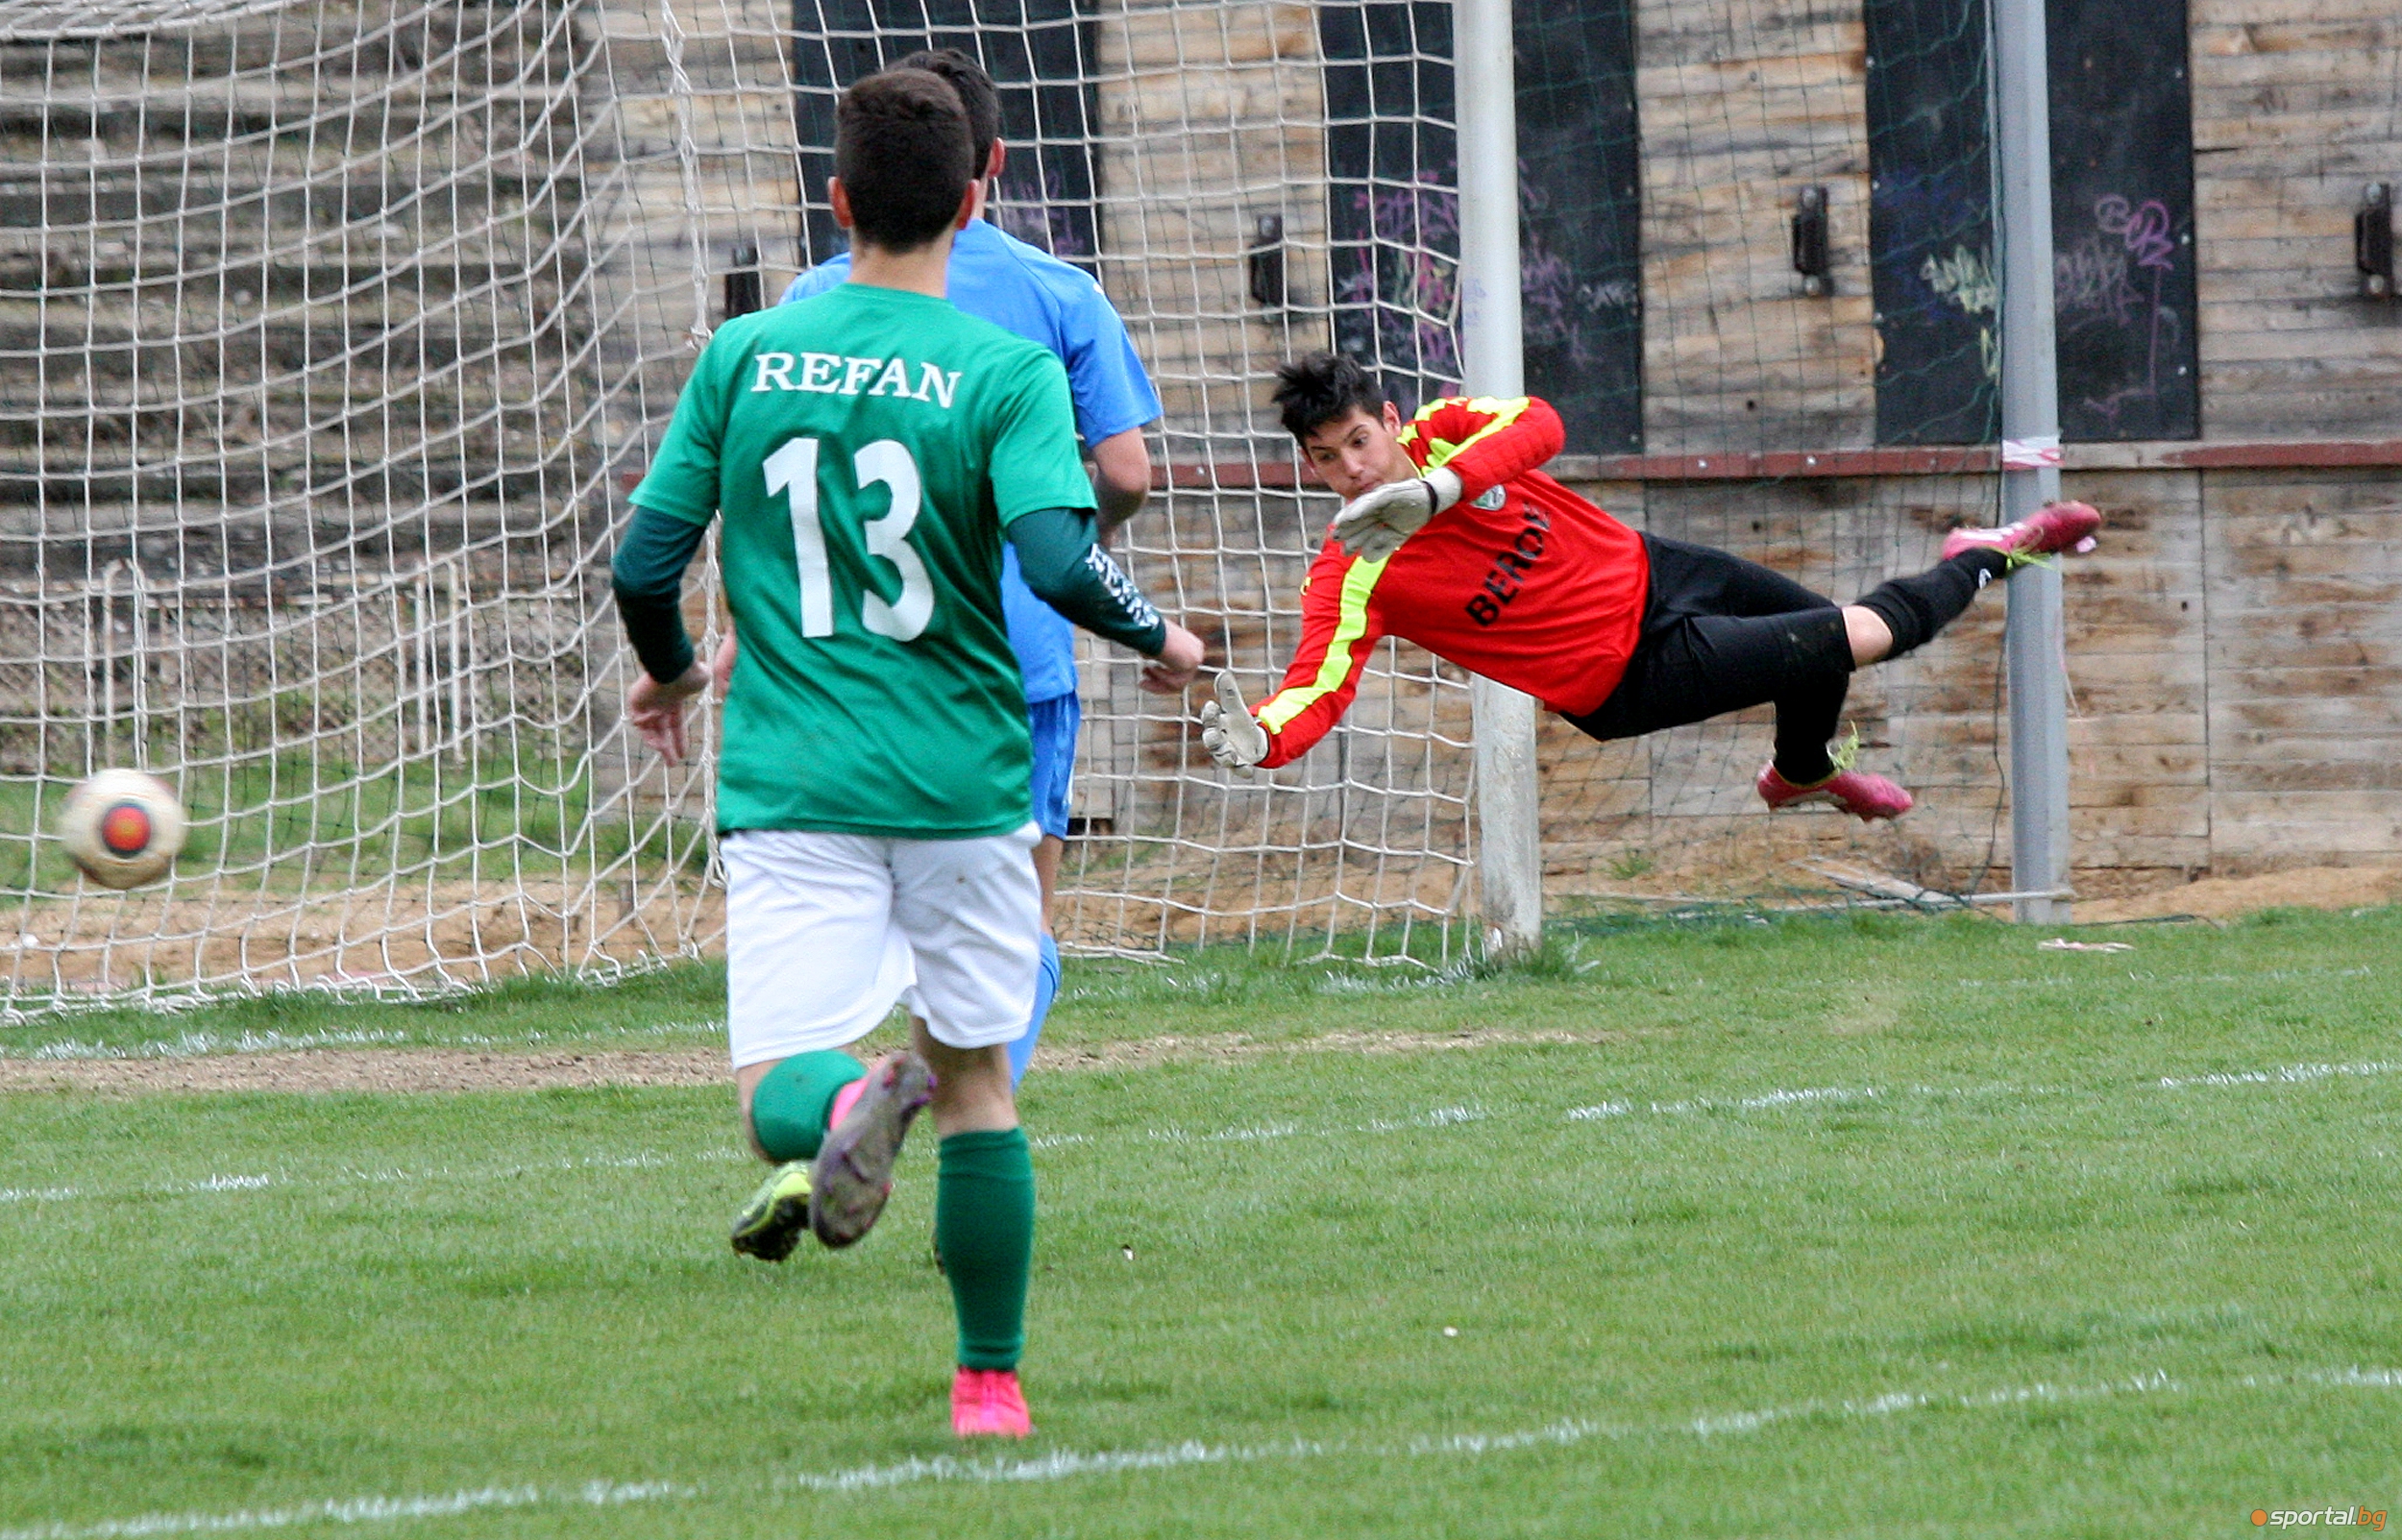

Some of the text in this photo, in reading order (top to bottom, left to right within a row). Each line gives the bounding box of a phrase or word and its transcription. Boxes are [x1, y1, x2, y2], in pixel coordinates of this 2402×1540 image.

[751, 352, 962, 408] REFAN
[763, 437, 934, 642] 13
[1465, 501, 1551, 626] BEROE
